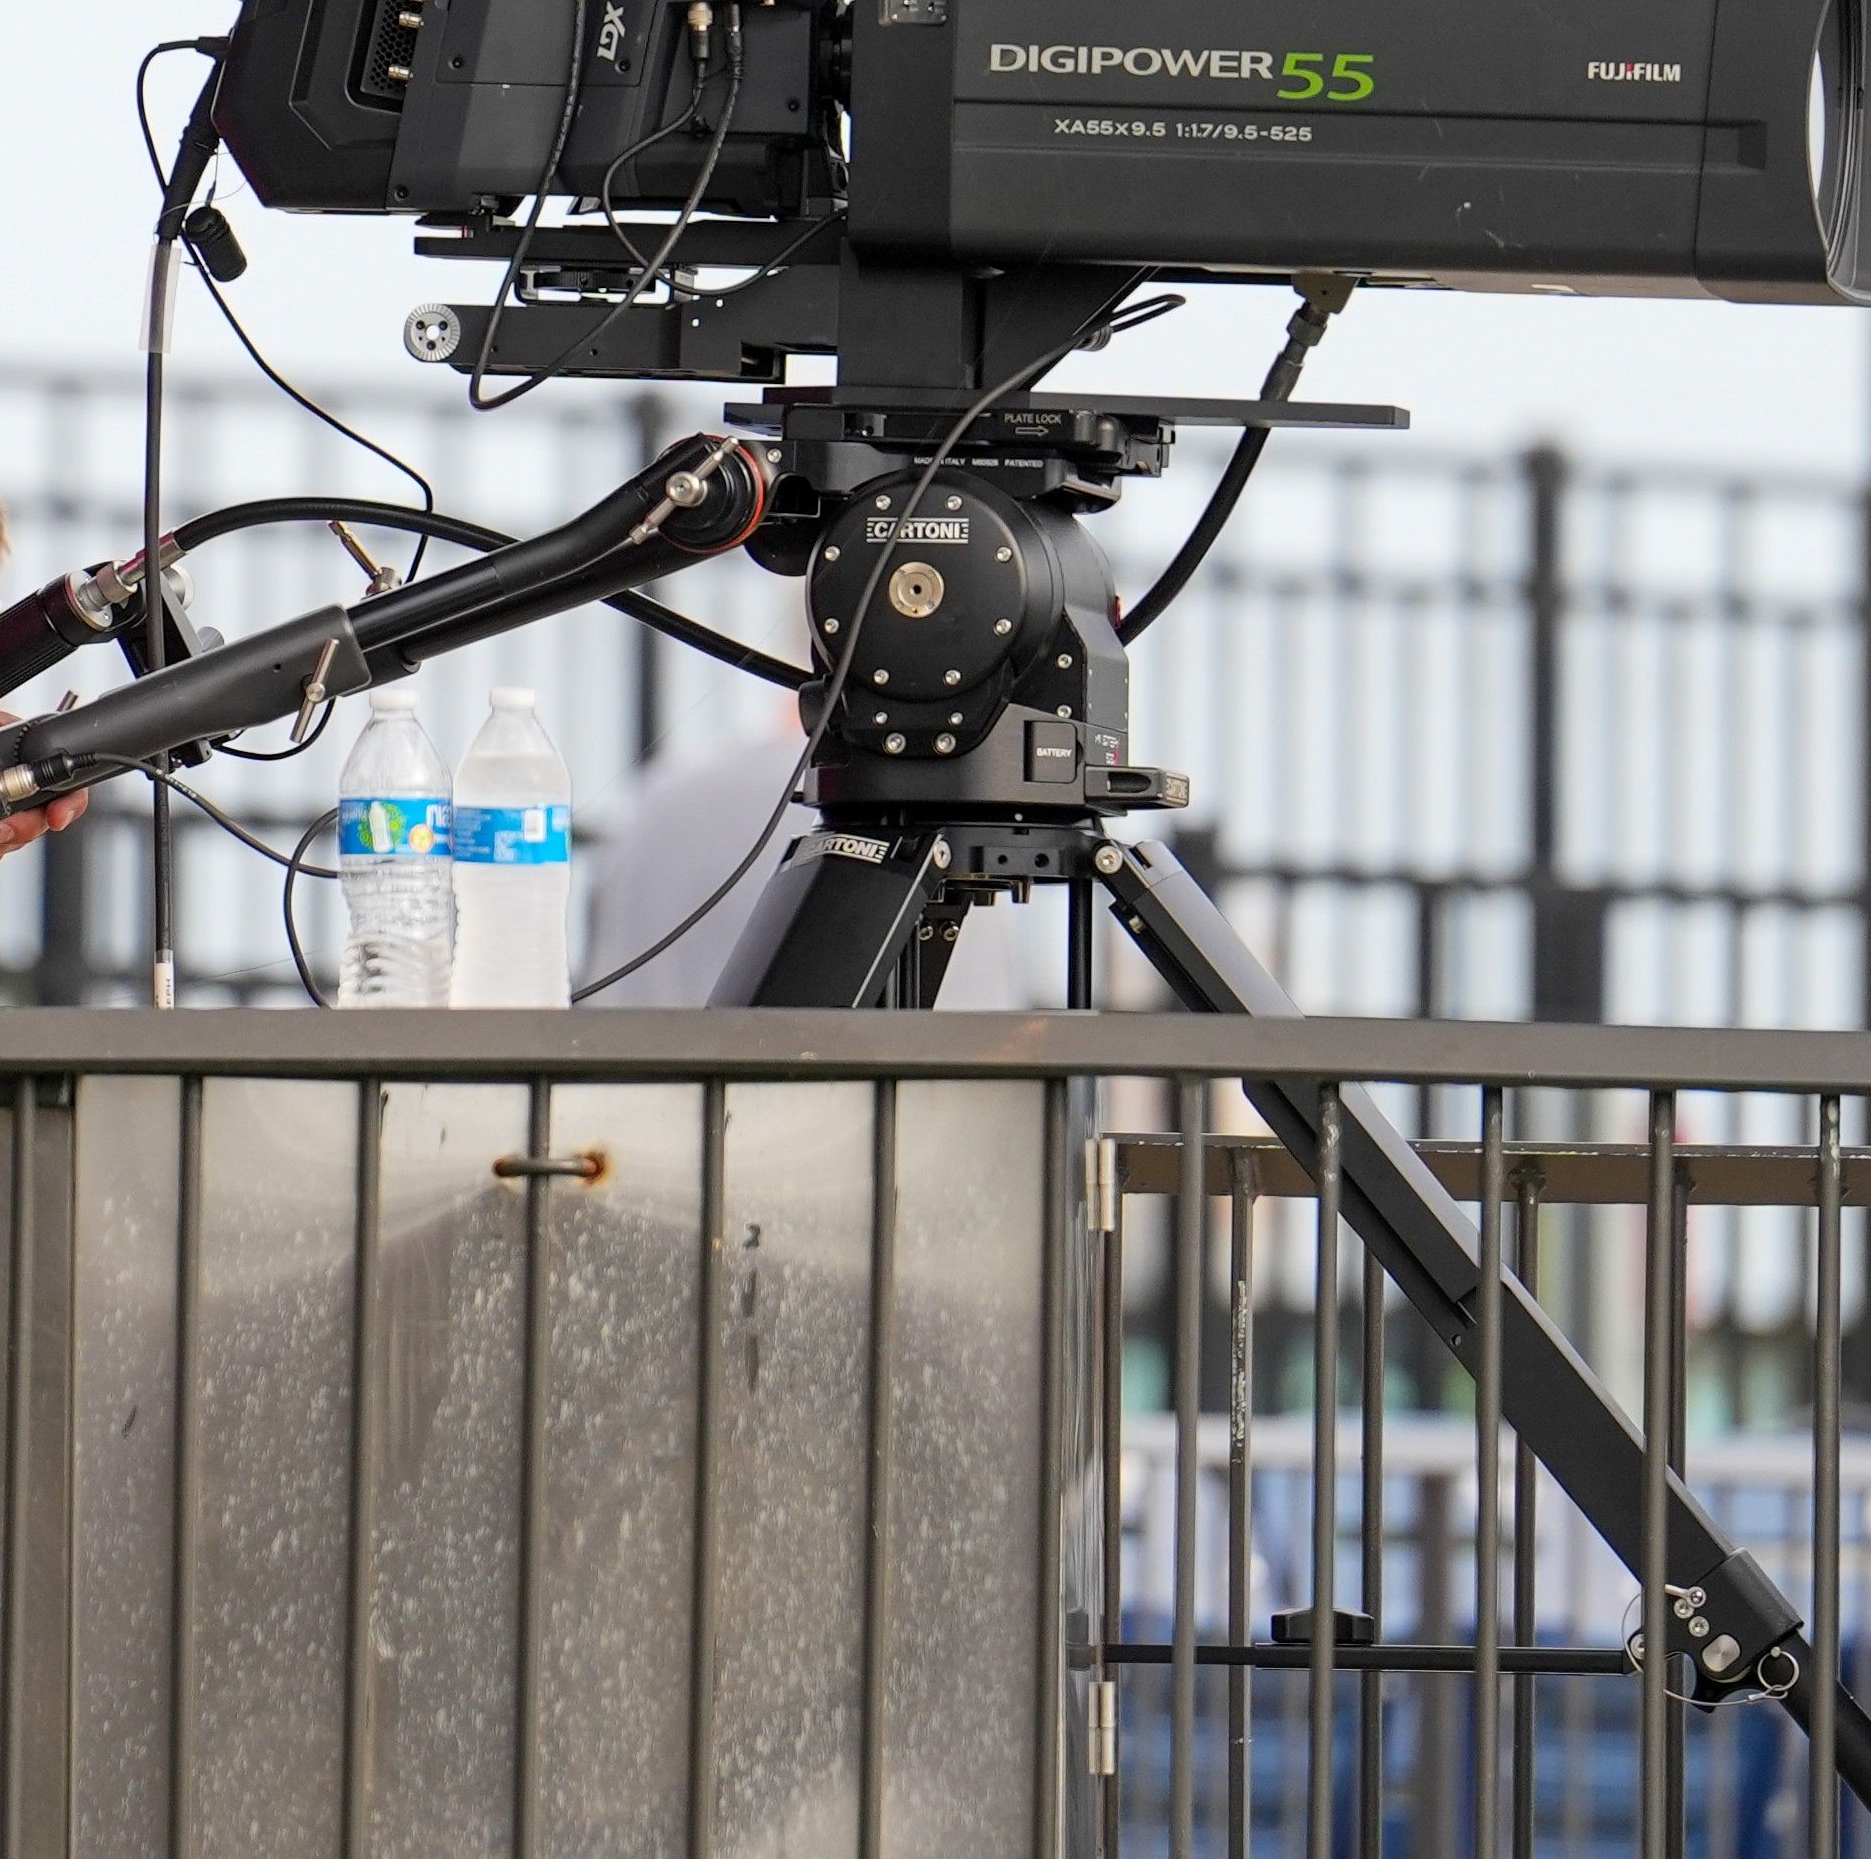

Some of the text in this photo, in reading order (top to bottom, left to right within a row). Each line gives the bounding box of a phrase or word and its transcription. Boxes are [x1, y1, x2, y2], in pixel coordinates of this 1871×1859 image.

[596, 0, 626, 62] LDX
[990, 43, 1375, 101] DIGIPOWER 55
[1587, 61, 1681, 82] FUJIFILM
[1004, 412, 1062, 424] PLATE LOCK
[1004, 458, 1043, 468] PATENTED
[1036, 747, 1072, 758] BATTERY
